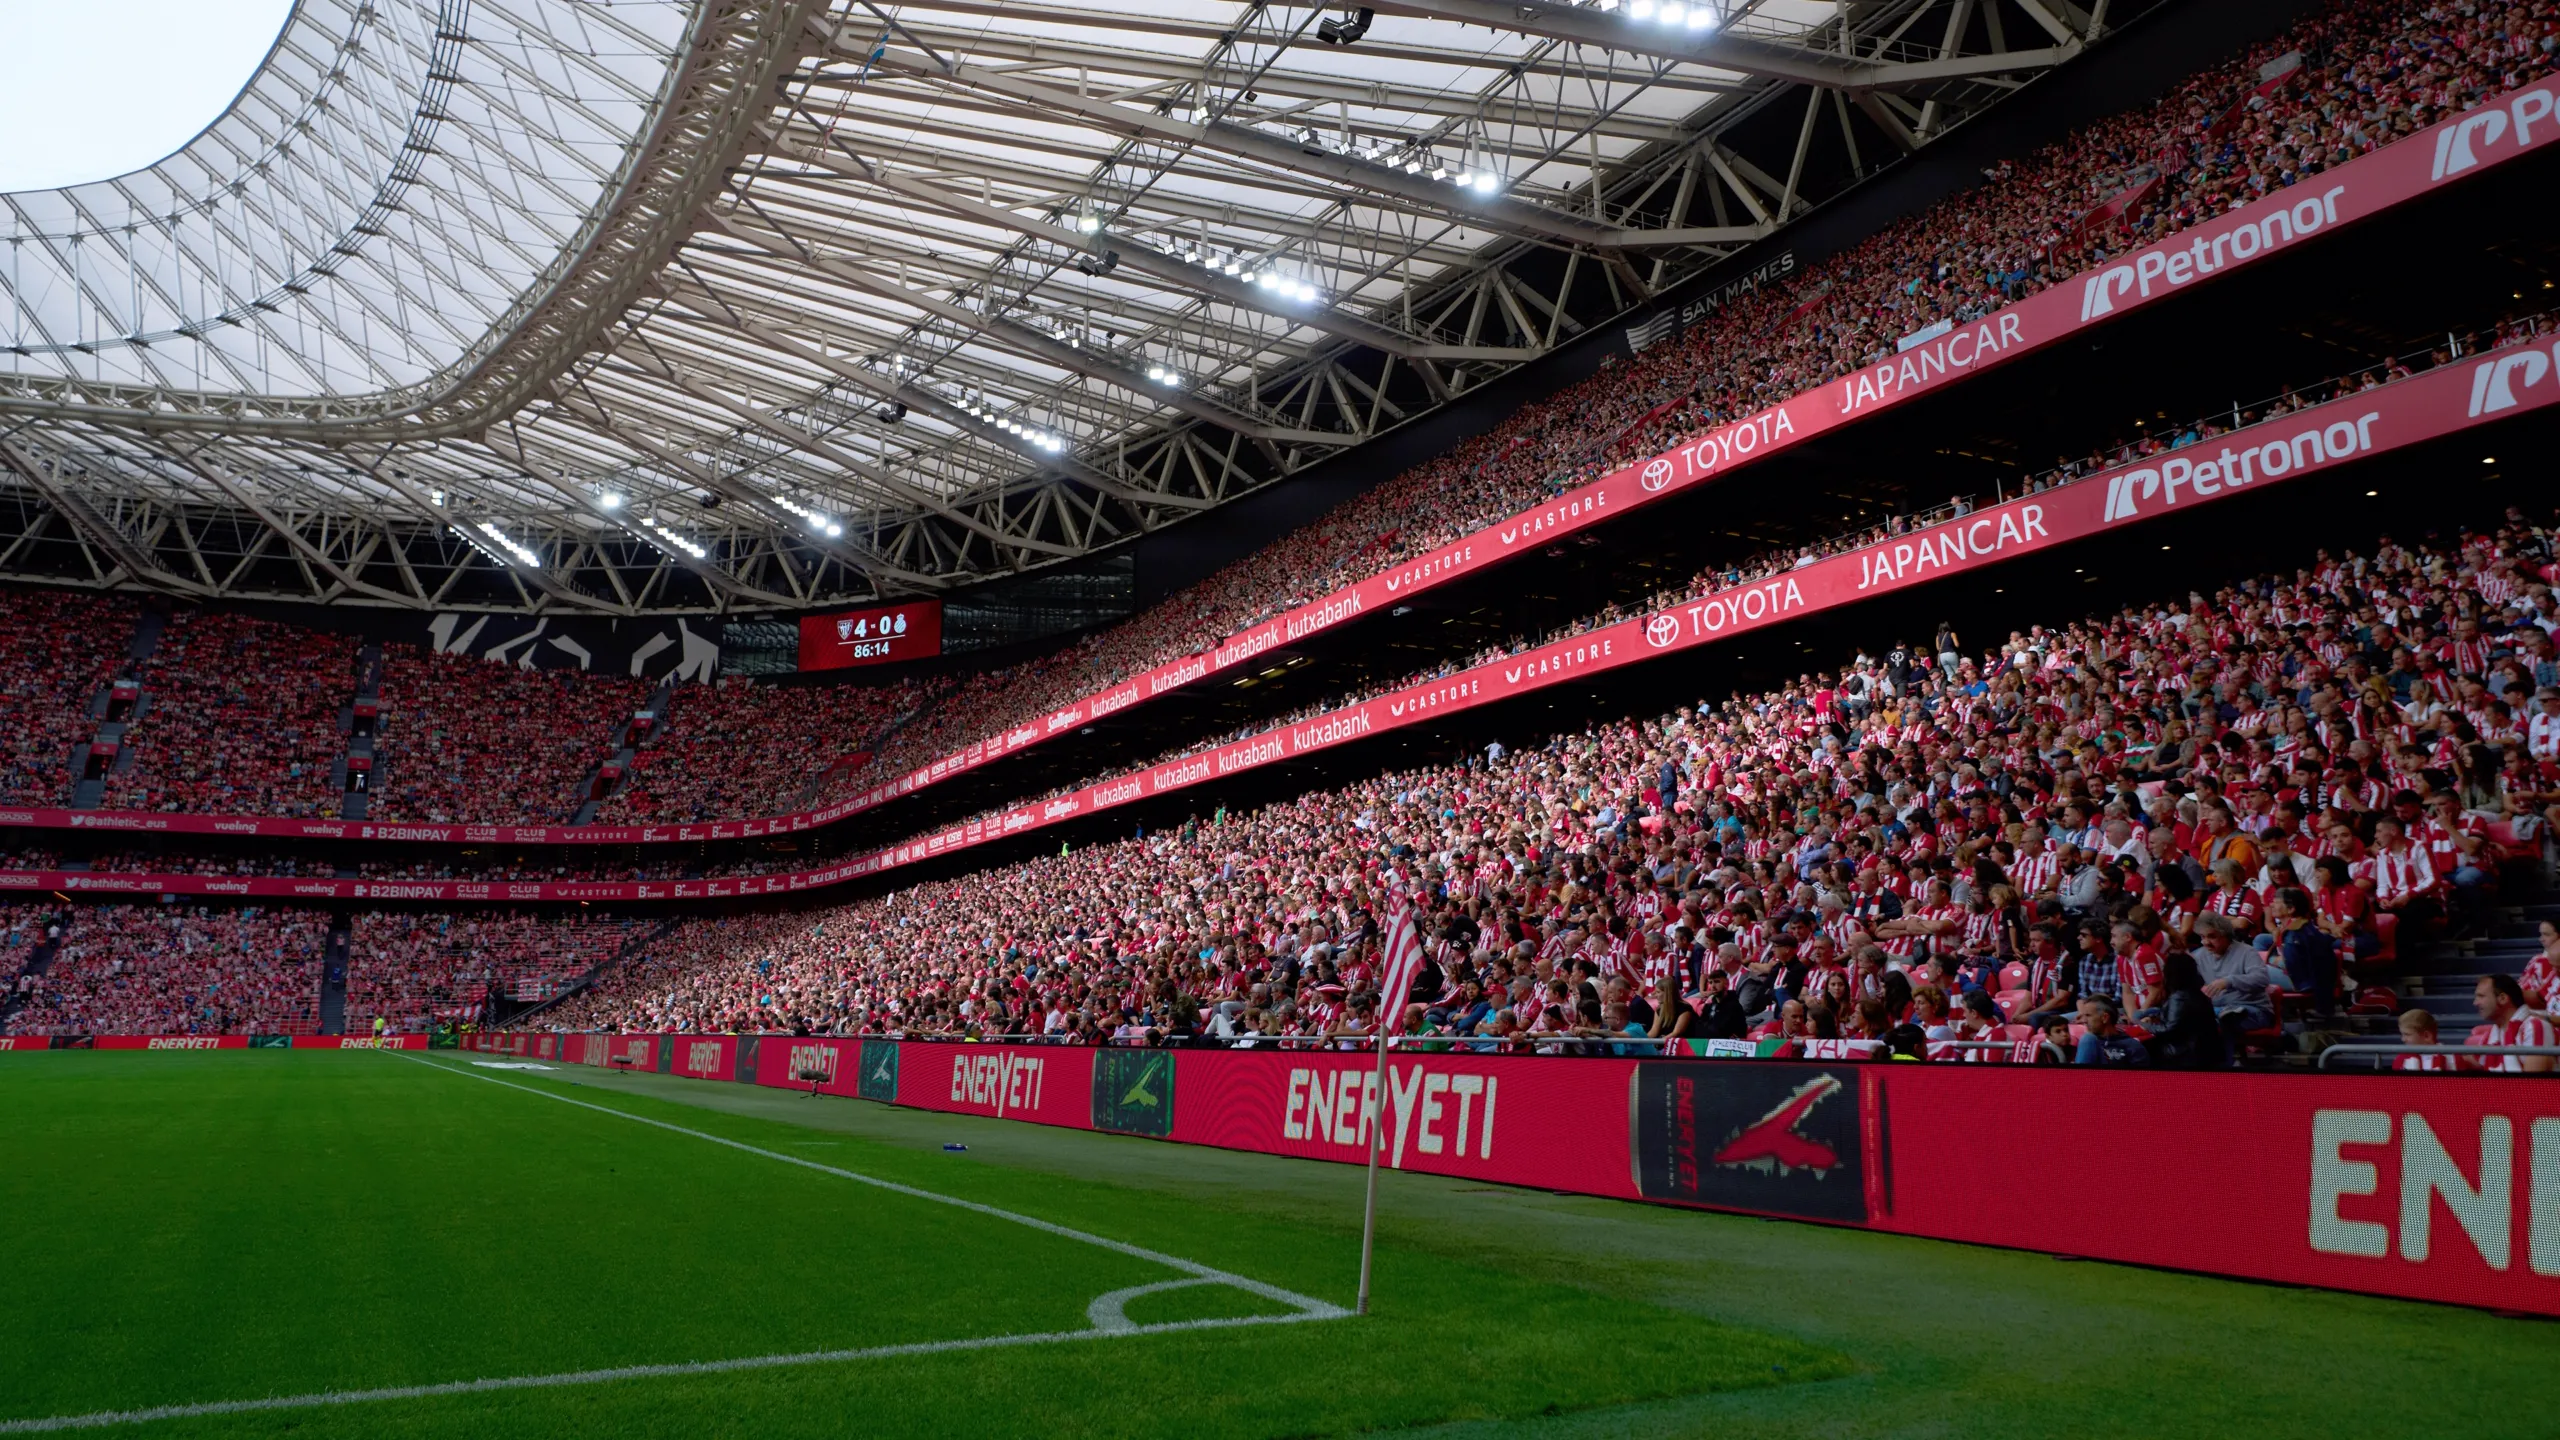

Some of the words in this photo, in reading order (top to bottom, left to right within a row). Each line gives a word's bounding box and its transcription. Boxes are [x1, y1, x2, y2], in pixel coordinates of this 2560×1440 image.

[2511, 89, 2560, 146] P
[2137, 186, 2344, 297] Petronor
[1682, 293, 1718, 323] SAN
[1726, 254, 1794, 303] MAMES
[1841, 312, 2024, 413] JAPANCAR
[1682, 408, 1794, 476] TOYOTA
[2162, 412, 2379, 504] Petronor
[1522, 491, 1605, 536] CASTORE
[1859, 504, 2048, 590] JAPANCAR
[1404, 547, 1471, 585] CASTORE
[1287, 589, 1361, 639] kutxabank
[1688, 578, 1804, 636] TOYOTA
[854, 619, 867, 637] 4
[879, 616, 891, 634] 0
[854, 642, 889, 658] 86:14
[1215, 624, 1279, 669] kutxabank
[1527, 640, 1611, 678] CASTORE
[1152, 659, 1205, 693] kutxabank
[1091, 684, 1138, 718] kutxabank
[1409, 679, 1478, 711] CASTORE
[1294, 707, 1370, 751] kutxabank
[968, 744, 982, 758] CLUB
[987, 736, 1002, 750] CLUB
[1219, 734, 1283, 773] kutxabank
[916, 769, 929, 785] IMQ
[1154, 756, 1210, 790] kutxabank
[885, 782, 897, 798] IMQ
[900, 776, 912, 791] IMQ
[1093, 777, 1141, 808] kutxabank
[871, 789, 883, 803] IMQ
[85, 816, 167, 828] @athletic_eus
[215, 821, 257, 833] vueling
[303, 824, 344, 837] vueling
[967, 823, 981, 835] CLUB
[986, 817, 1000, 830] CLUB
[378, 827, 450, 841] B2BINPAY
[466, 828, 496, 836] CLUB
[896, 847, 909, 862] IMQ
[912, 842, 925, 857] IMQ
[867, 857, 879, 871] IMQ
[882, 853, 894, 867] IMQ
[80, 877, 163, 890] @athletic_eus
[206, 881, 248, 894] vueling
[295, 883, 336, 896] vueling
[371, 885, 444, 898] B2BINPAY
[457, 885, 489, 893] CLUB
[509, 885, 540, 893] CLUB
[148, 1037, 219, 1049] ENERYETI
[688, 1040, 721, 1078] ENERYETI
[788, 1043, 838, 1090] ENERYETI
[951, 1051, 1043, 1117] ENERYETI
[1284, 1064, 1497, 1168] ENERYETI
